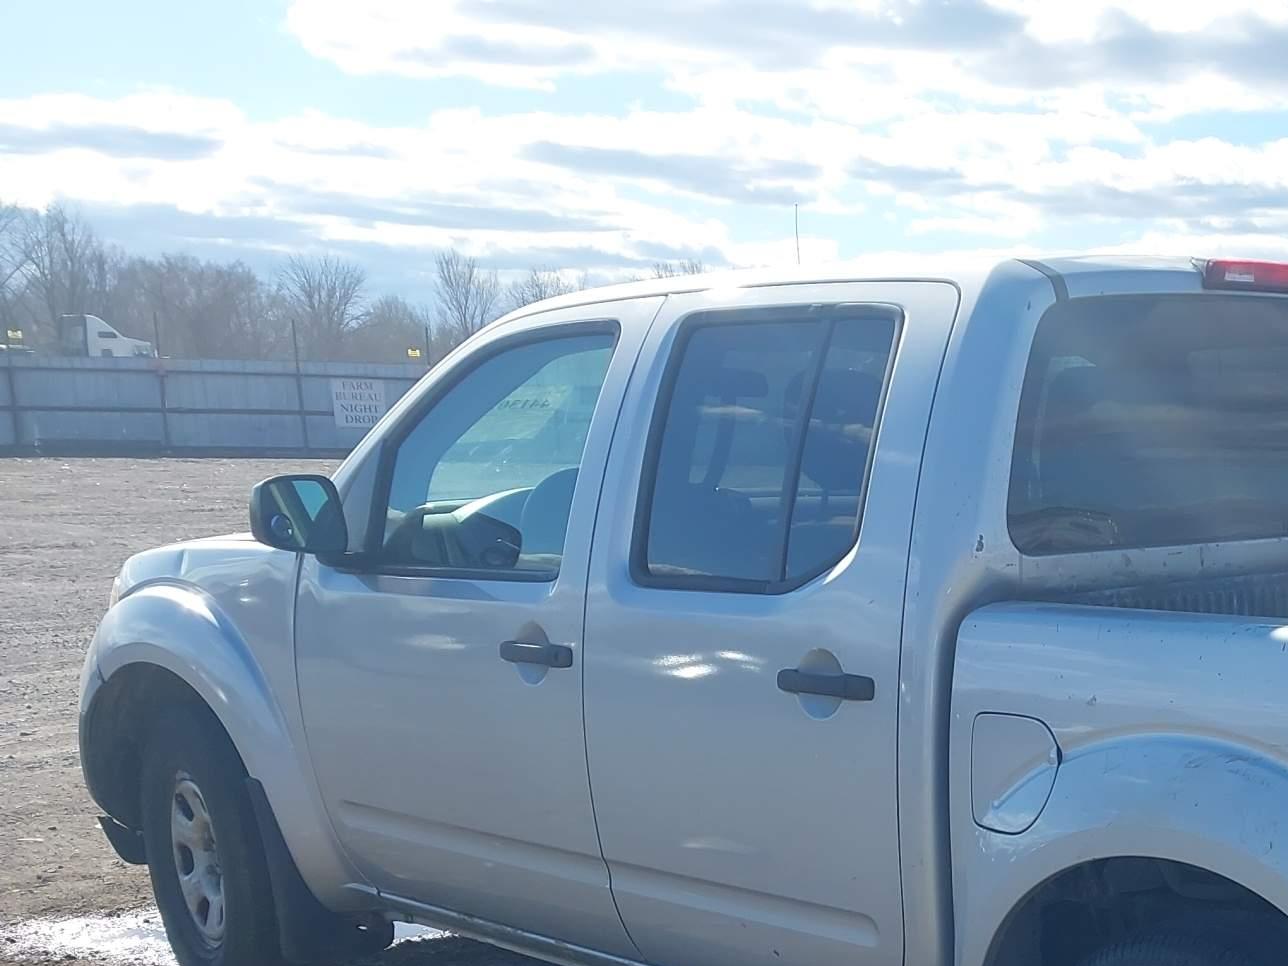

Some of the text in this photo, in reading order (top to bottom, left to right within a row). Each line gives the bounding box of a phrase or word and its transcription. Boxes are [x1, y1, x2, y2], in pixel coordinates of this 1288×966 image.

[342, 381, 373, 391] FARM
[335, 391, 382, 402] BUREAU
[340, 403, 379, 414] NIGHT
[345, 414, 379, 424] DROP
